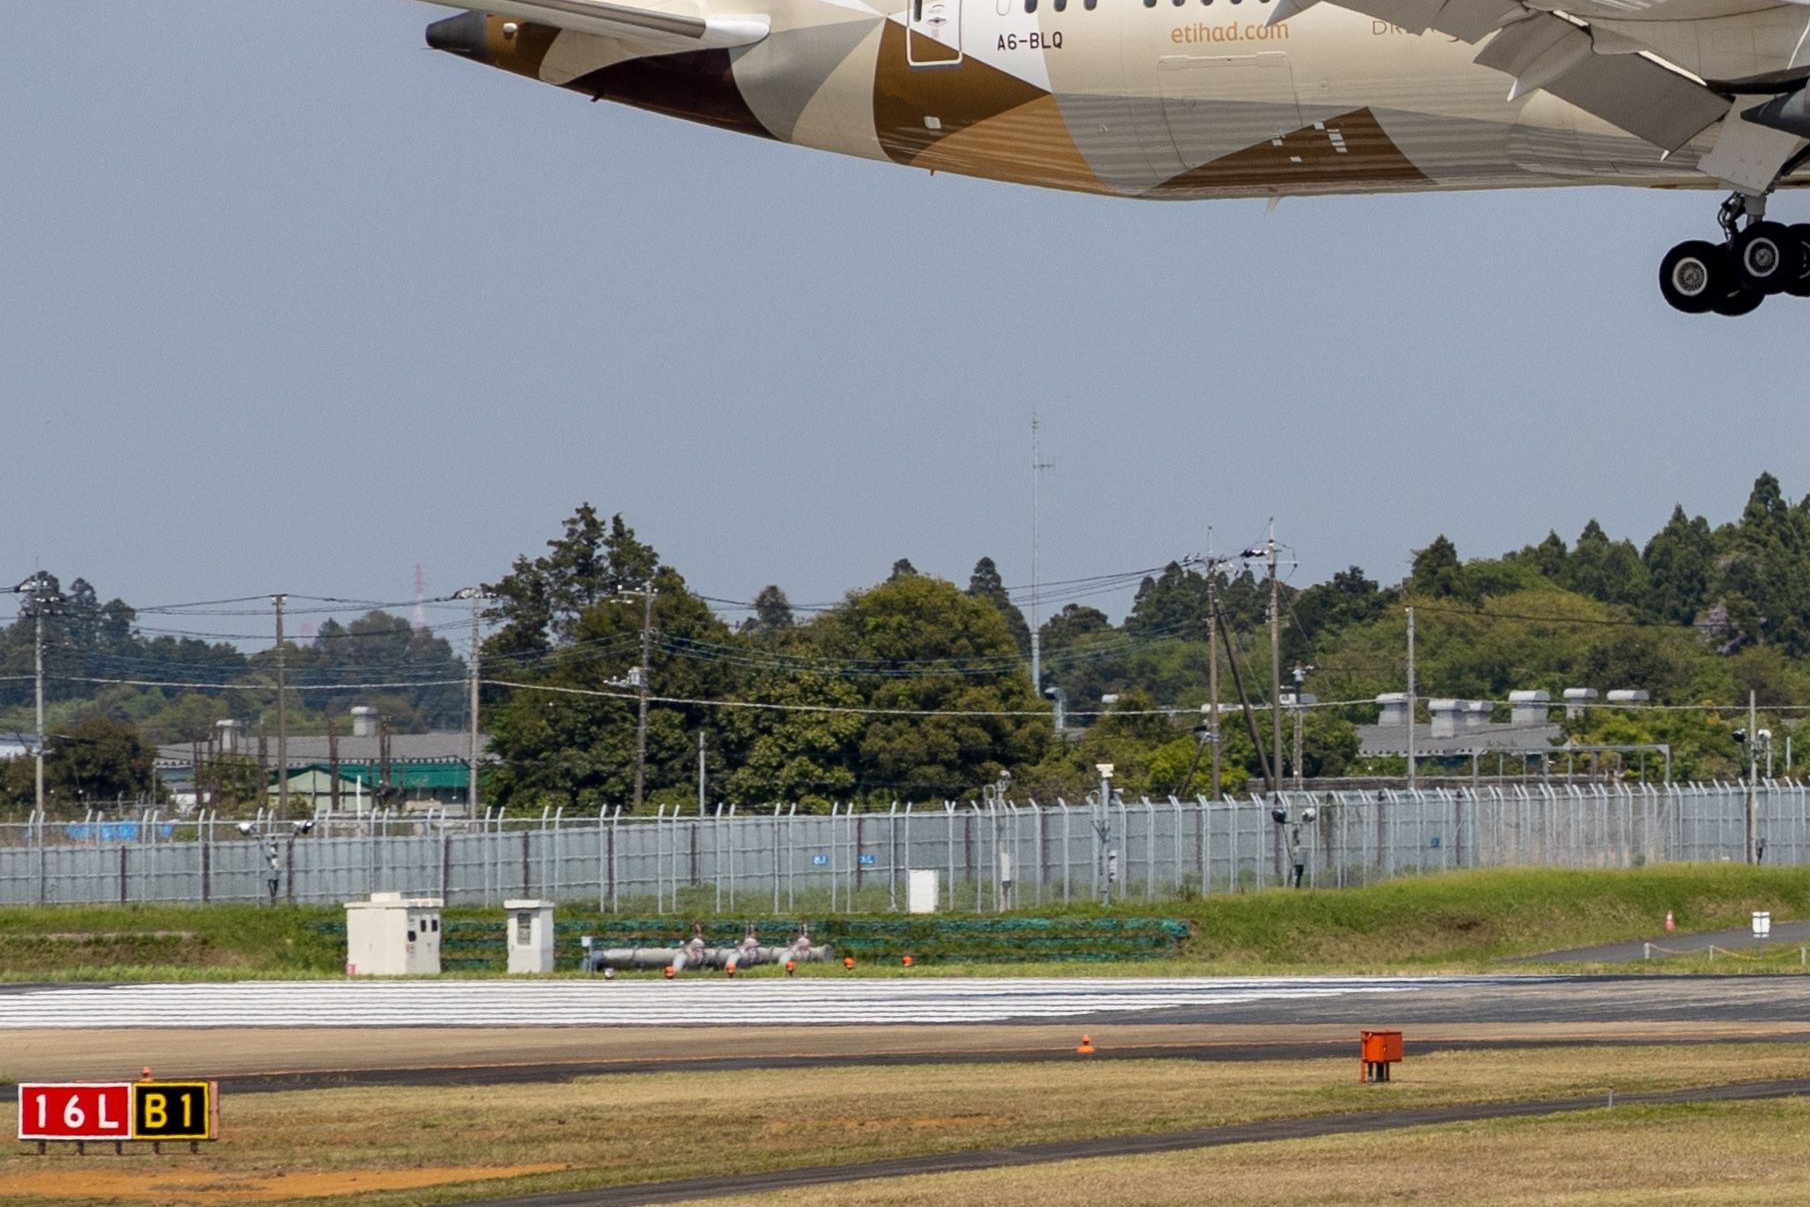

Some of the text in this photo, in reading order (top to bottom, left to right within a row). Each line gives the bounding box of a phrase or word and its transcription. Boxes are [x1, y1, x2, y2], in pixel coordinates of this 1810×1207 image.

[997, 31, 1063, 51] A6-BLQ
[1170, 21, 1290, 44] etihad.com
[36, 1094, 119, 1129] 16L
[145, 1093, 191, 1128] B1
